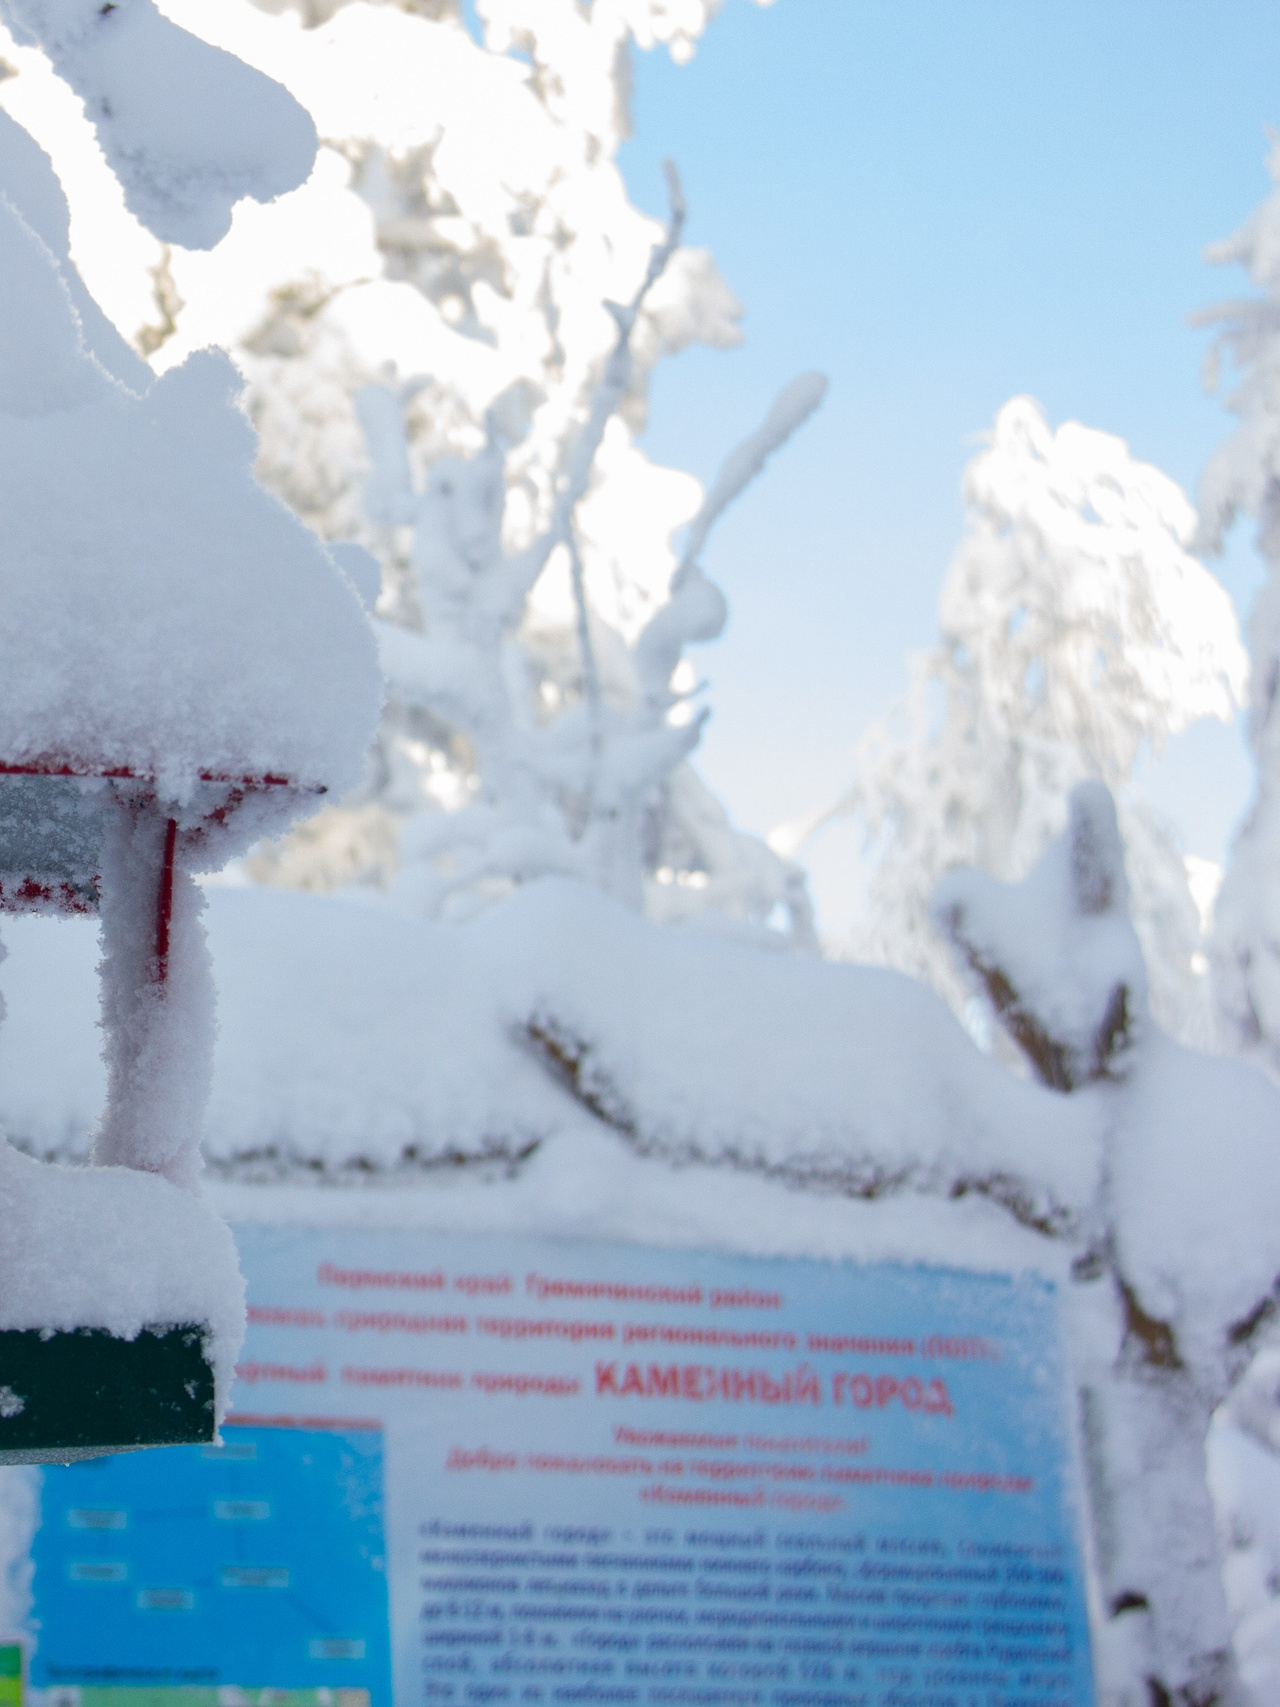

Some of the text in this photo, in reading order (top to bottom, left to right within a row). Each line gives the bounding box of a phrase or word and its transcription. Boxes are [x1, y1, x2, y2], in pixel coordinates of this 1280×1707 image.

[318, 1262, 444, 1289] Пермский
[453, 1270, 512, 1296] край
[710, 1284, 782, 1308] район
[476, 1316, 614, 1340] территория
[623, 1322, 797, 1346] регионального
[808, 1332, 915, 1354] значения
[594, 1360, 820, 1403] КАМЕННЫЙ
[832, 1373, 954, 1418] ГОРОД
[445, 1443, 517, 1471] Добро
